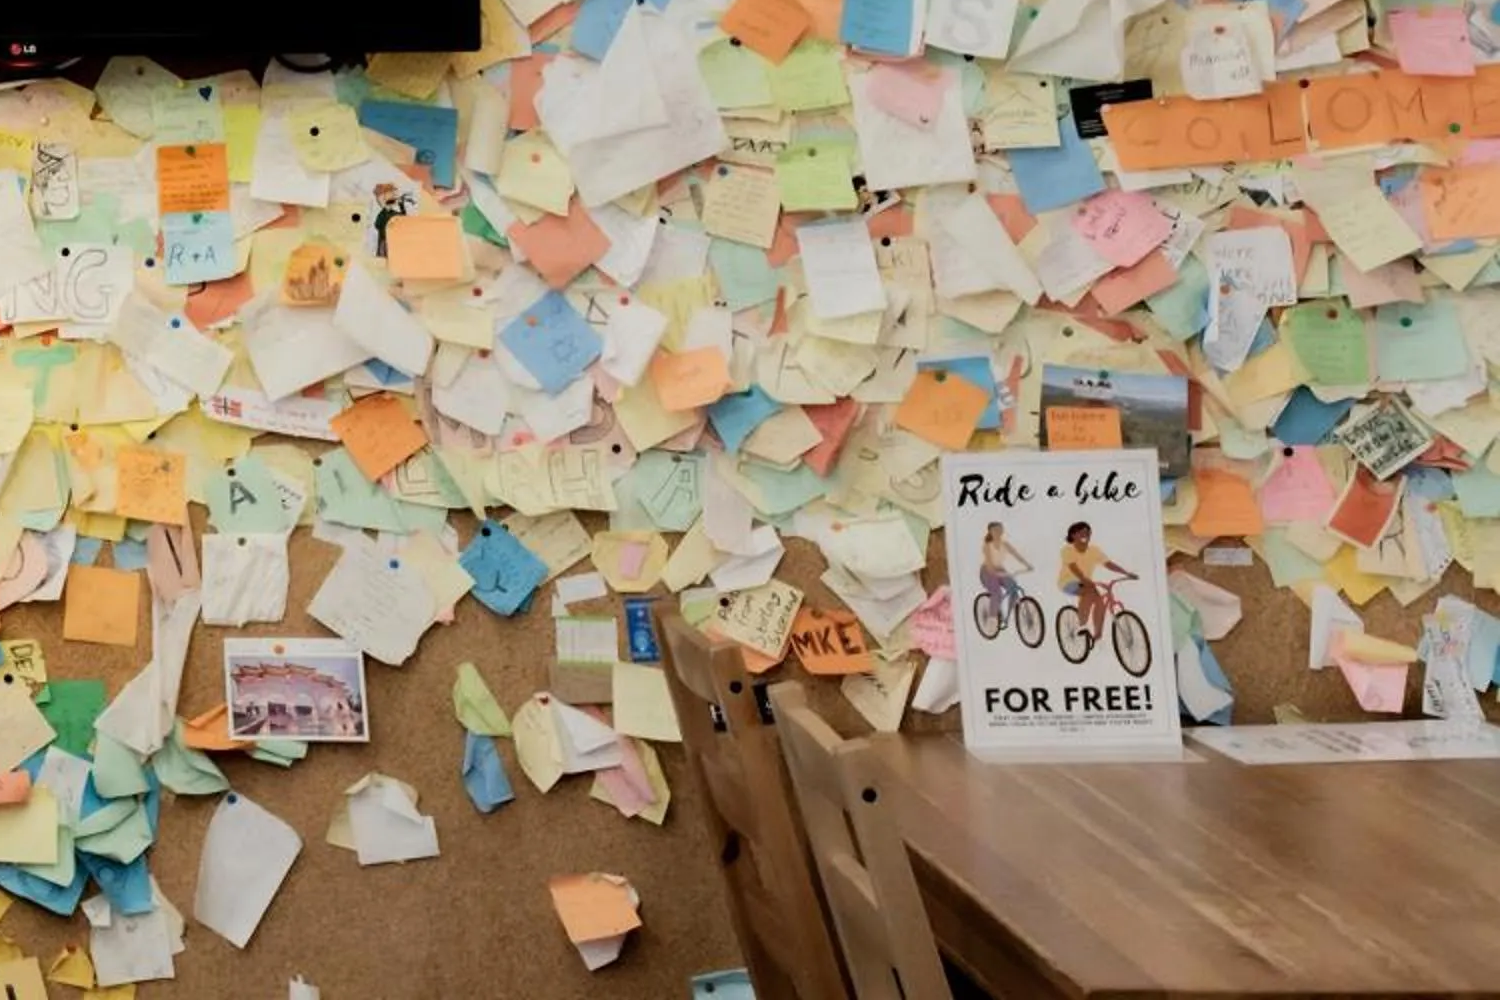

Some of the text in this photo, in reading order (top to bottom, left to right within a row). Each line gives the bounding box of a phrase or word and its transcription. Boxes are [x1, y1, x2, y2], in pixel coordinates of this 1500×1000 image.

[957, 471, 1142, 508] Ride a bike
[790, 621, 864, 660] MKE
[985, 684, 1154, 713] FOR FREE!
